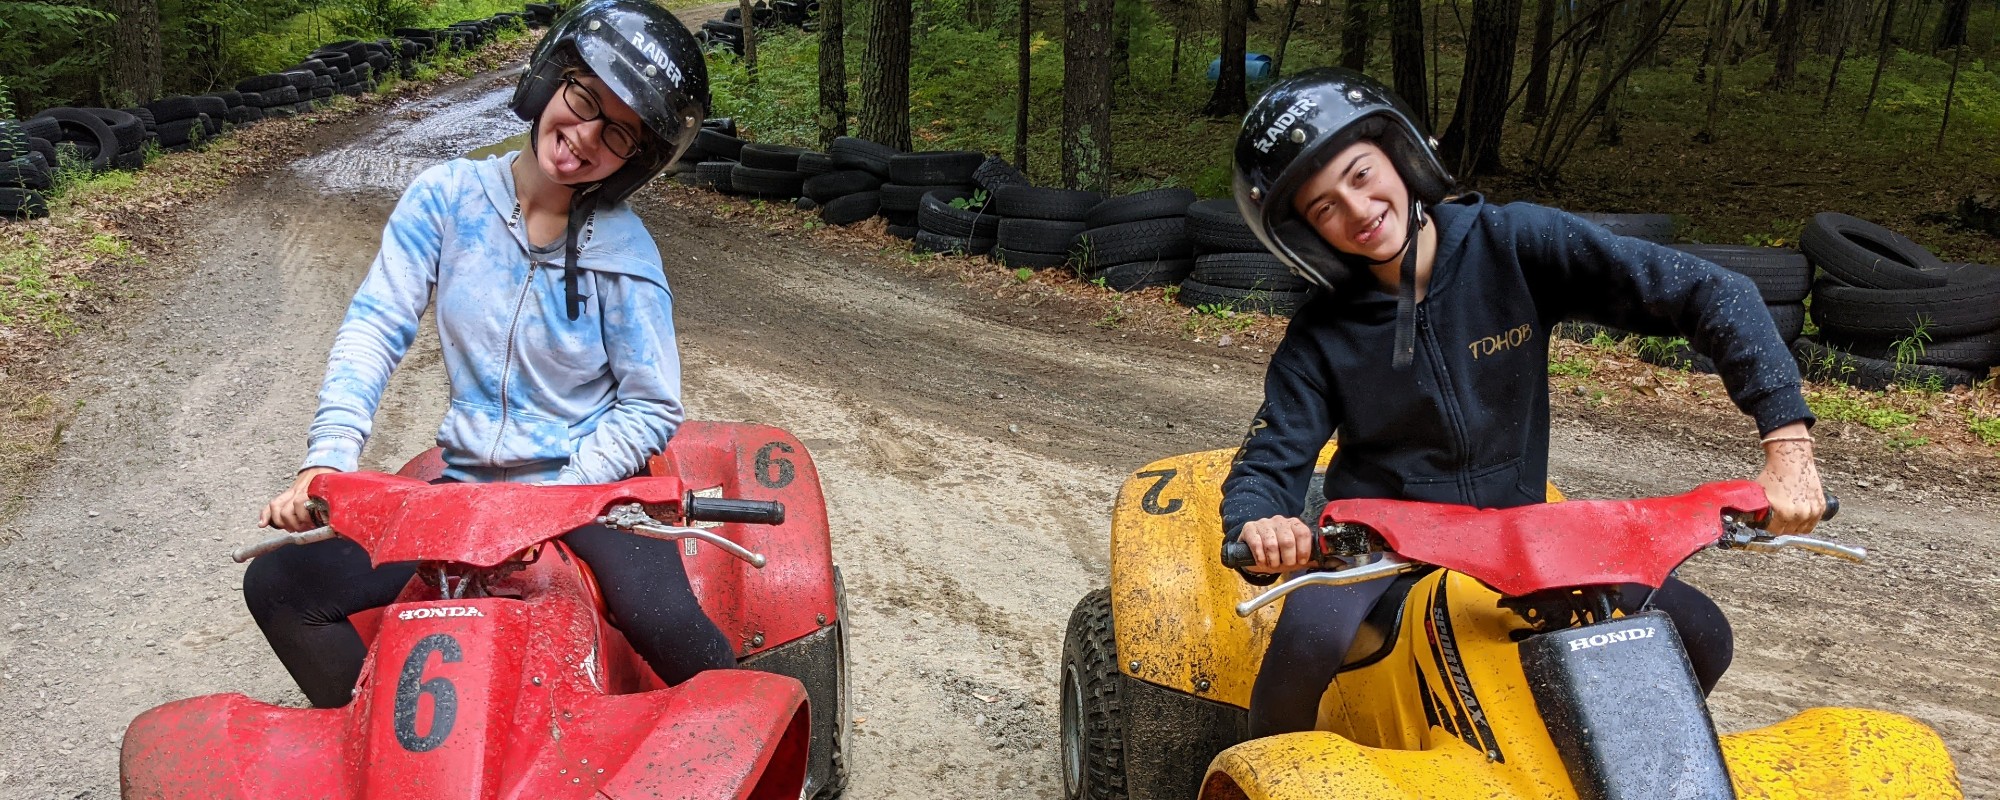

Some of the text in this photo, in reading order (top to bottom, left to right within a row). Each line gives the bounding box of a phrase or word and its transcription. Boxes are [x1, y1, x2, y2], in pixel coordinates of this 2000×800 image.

[631, 31, 682, 88] RAIDER
[1257, 99, 1317, 154] RAIDER
[1469, 323, 1533, 360] TDHOB
[755, 441, 795, 488] 6
[1136, 468, 1183, 515] 2
[398, 606, 485, 620] HONDA
[1434, 607, 1489, 727] SPORTRAX
[394, 633, 464, 753] 6
